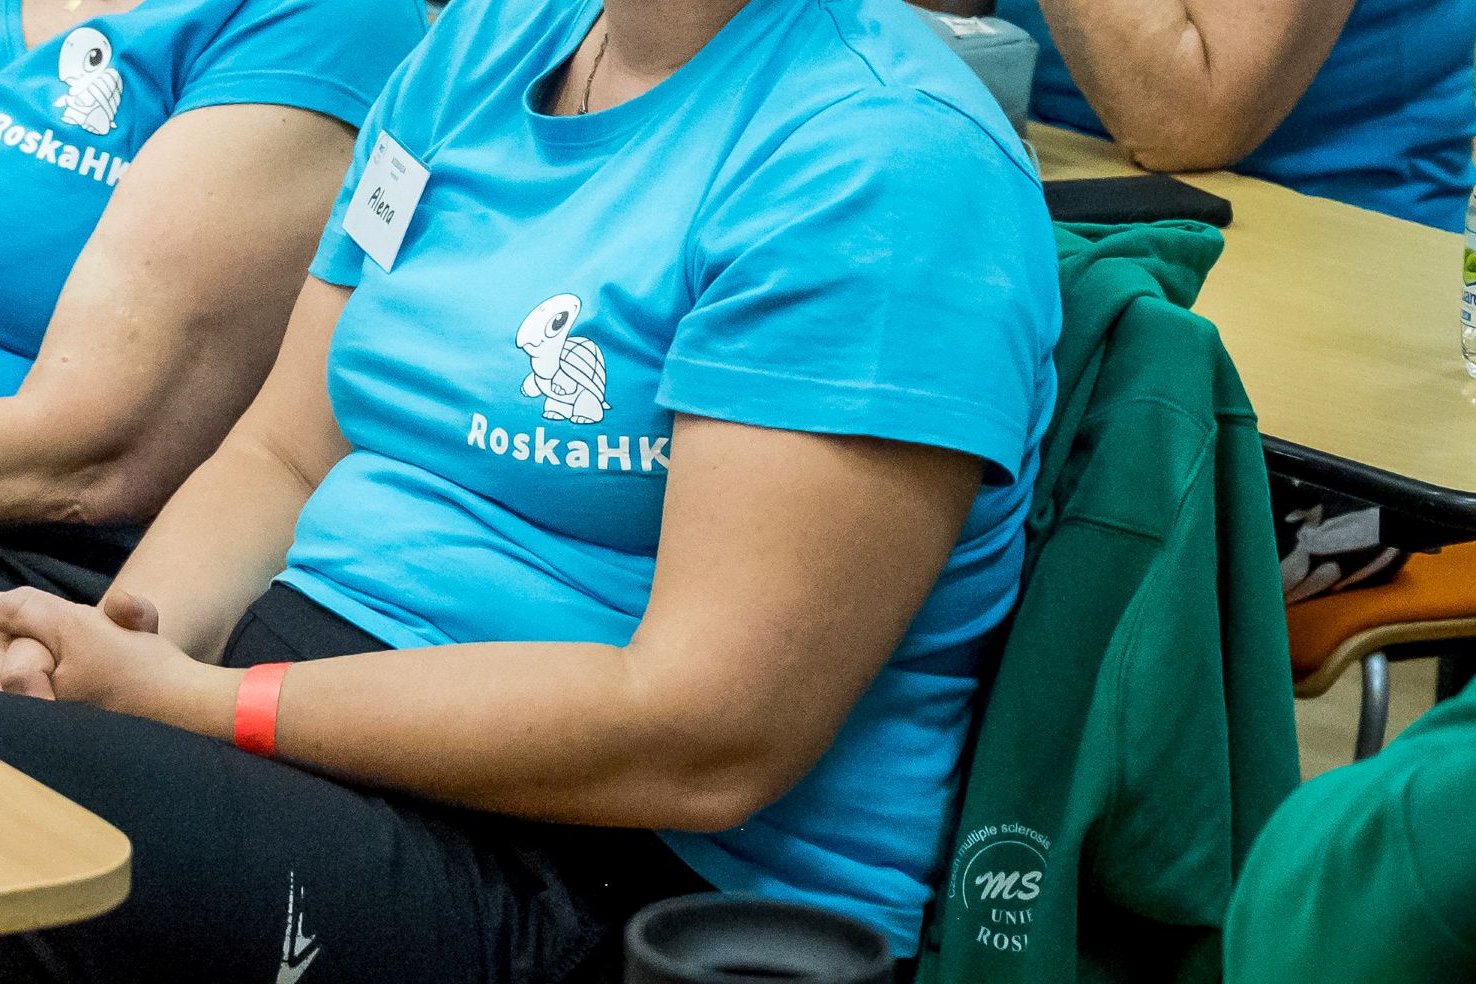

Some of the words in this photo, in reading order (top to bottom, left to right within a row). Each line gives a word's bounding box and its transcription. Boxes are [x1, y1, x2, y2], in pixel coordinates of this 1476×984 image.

[367, 186, 395, 225] Alena
[467, 412, 671, 472] RoskaHK
[958, 824, 998, 857] multiple
[1001, 822, 1052, 850] sclerosis
[975, 870, 1043, 900] MS
